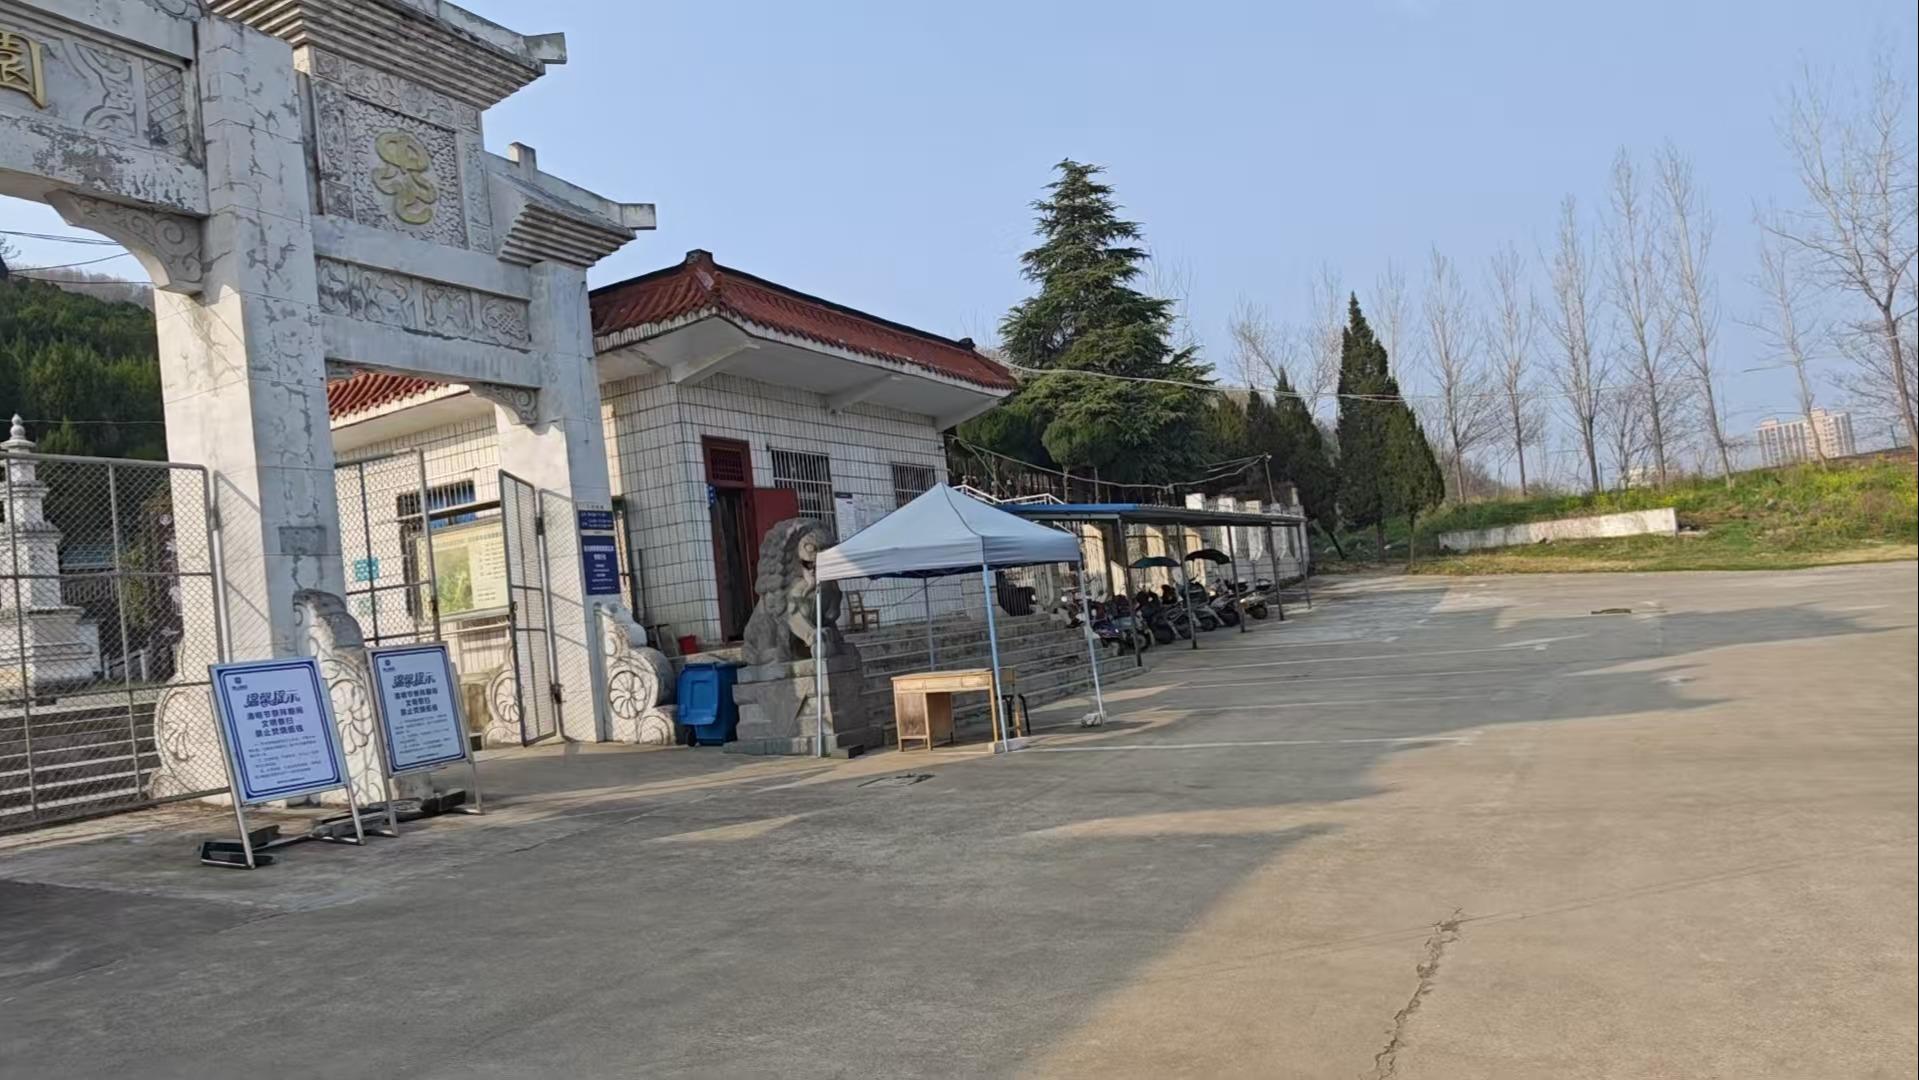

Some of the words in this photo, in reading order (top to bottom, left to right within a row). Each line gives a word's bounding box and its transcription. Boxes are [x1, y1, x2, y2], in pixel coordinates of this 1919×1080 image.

[392, 672, 436, 688] 温馨提示
[243, 689, 301, 708] 温馨提示
